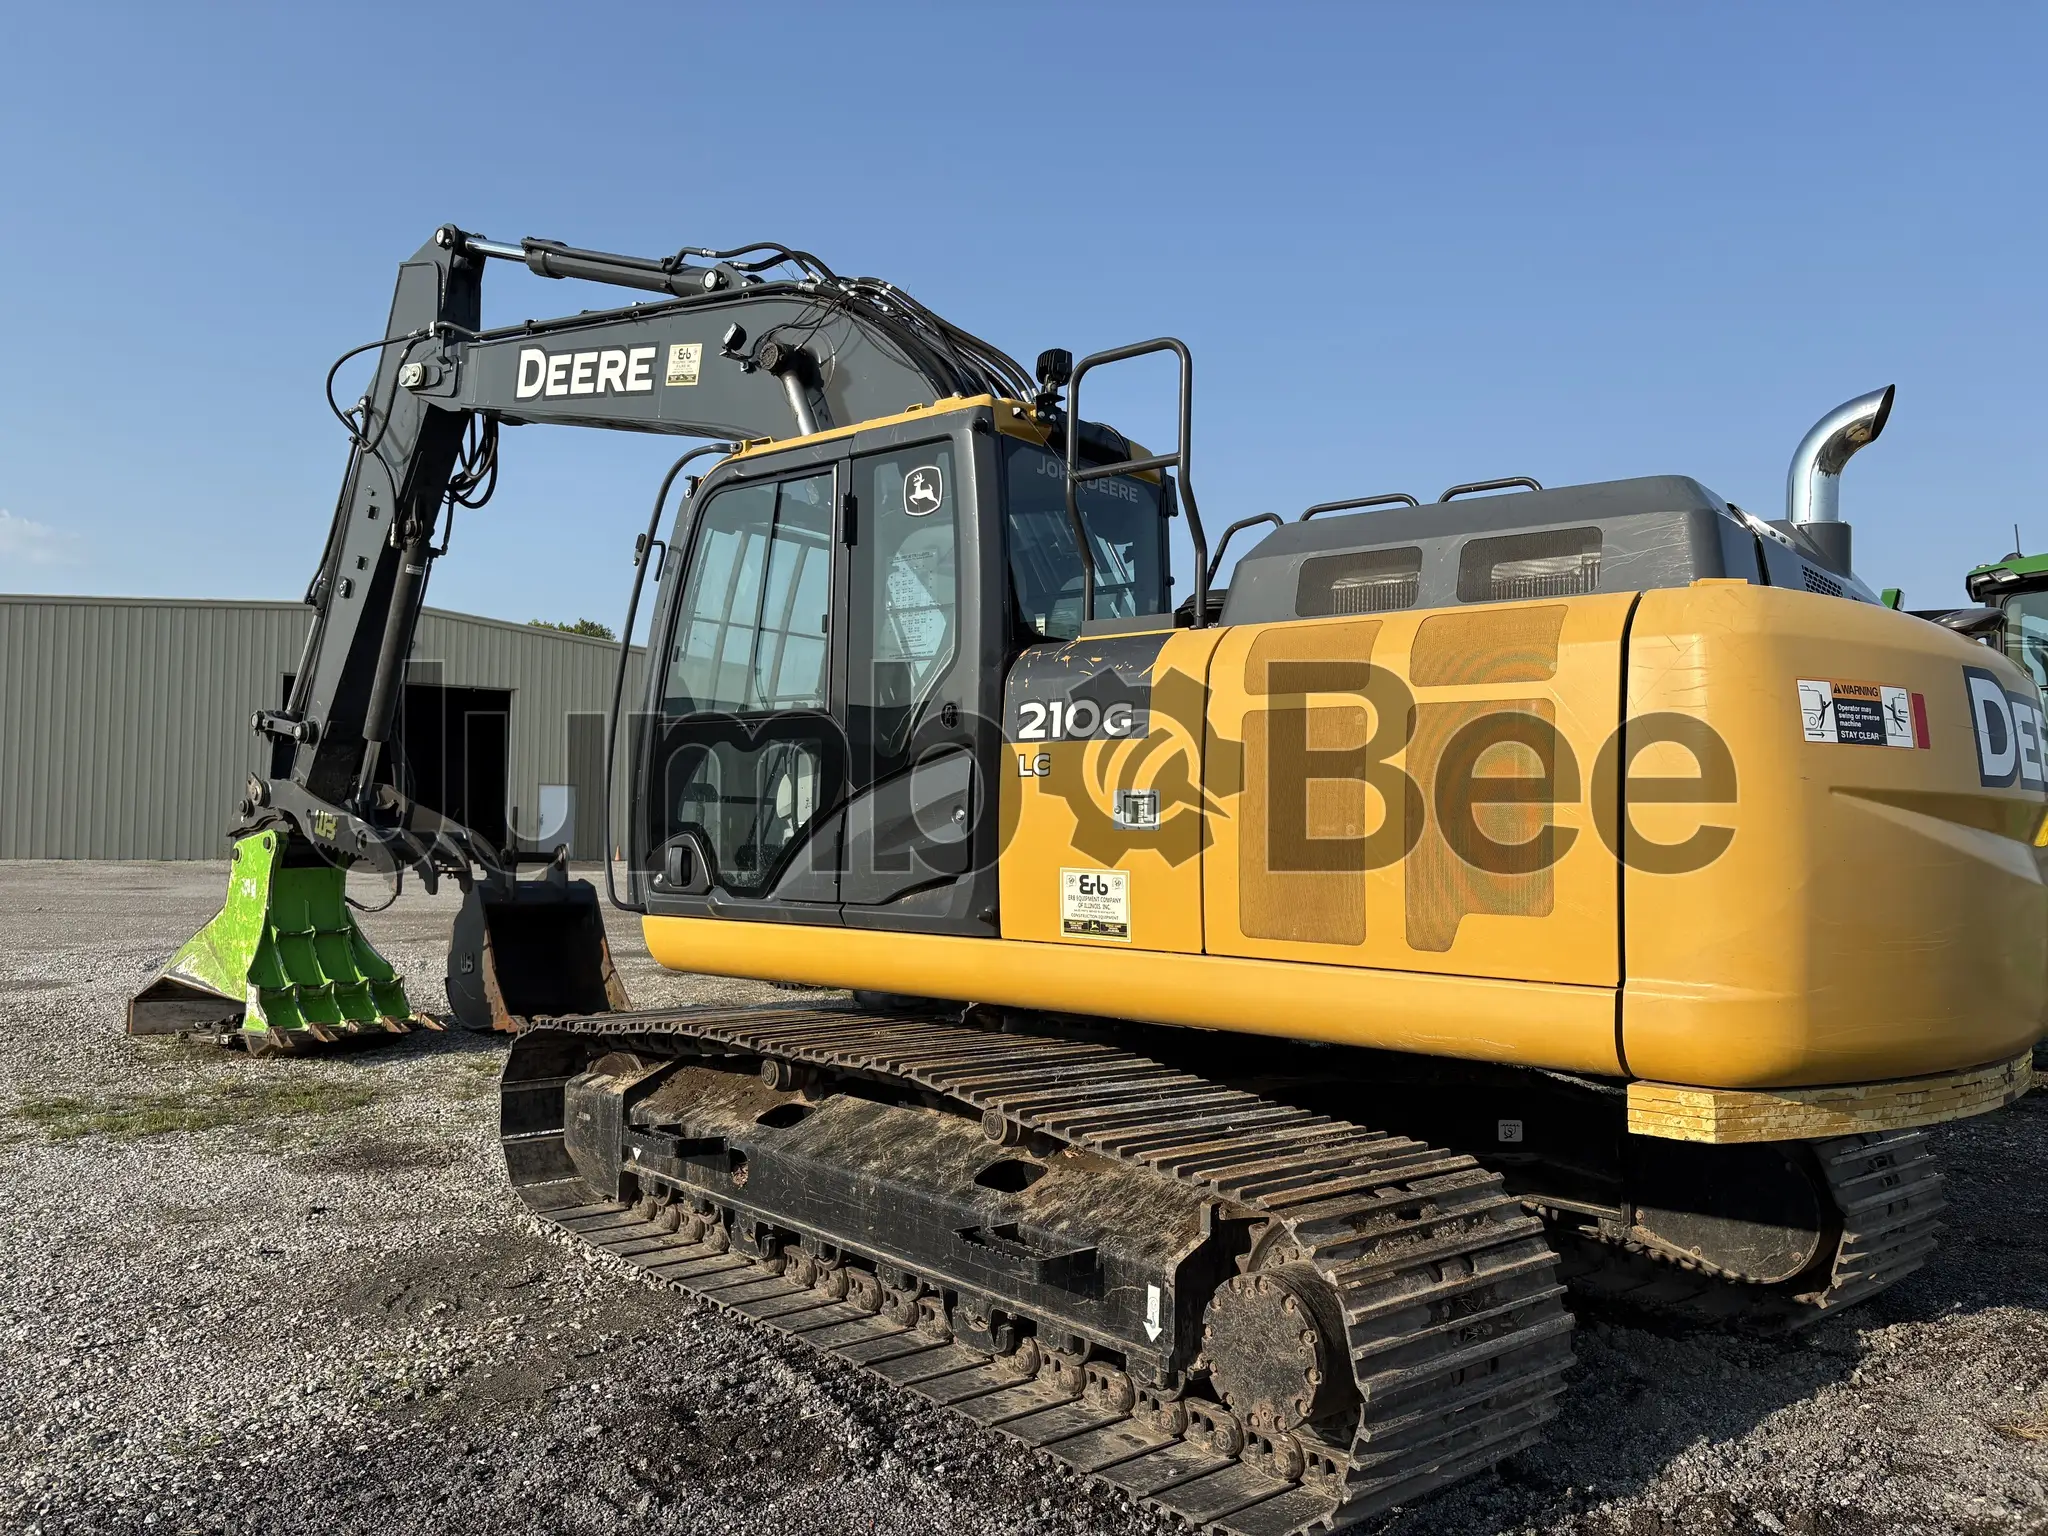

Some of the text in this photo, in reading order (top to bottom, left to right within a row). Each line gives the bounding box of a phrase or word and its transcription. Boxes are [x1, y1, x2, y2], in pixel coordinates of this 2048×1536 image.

[516, 347, 656, 398] DEERE
[1037, 455, 1075, 482] JOH
[1841, 684, 1879, 697] WARNING
[1837, 704, 1872, 714] Operator may
[1838, 713, 1855, 721] swing
[1018, 699, 1133, 739] 210G
[1840, 720, 1862, 728] machine
[1840, 730, 1880, 740] STAY CLEAR
[1019, 754, 1051, 776] LC
[1079, 874, 1109, 896] Erb
